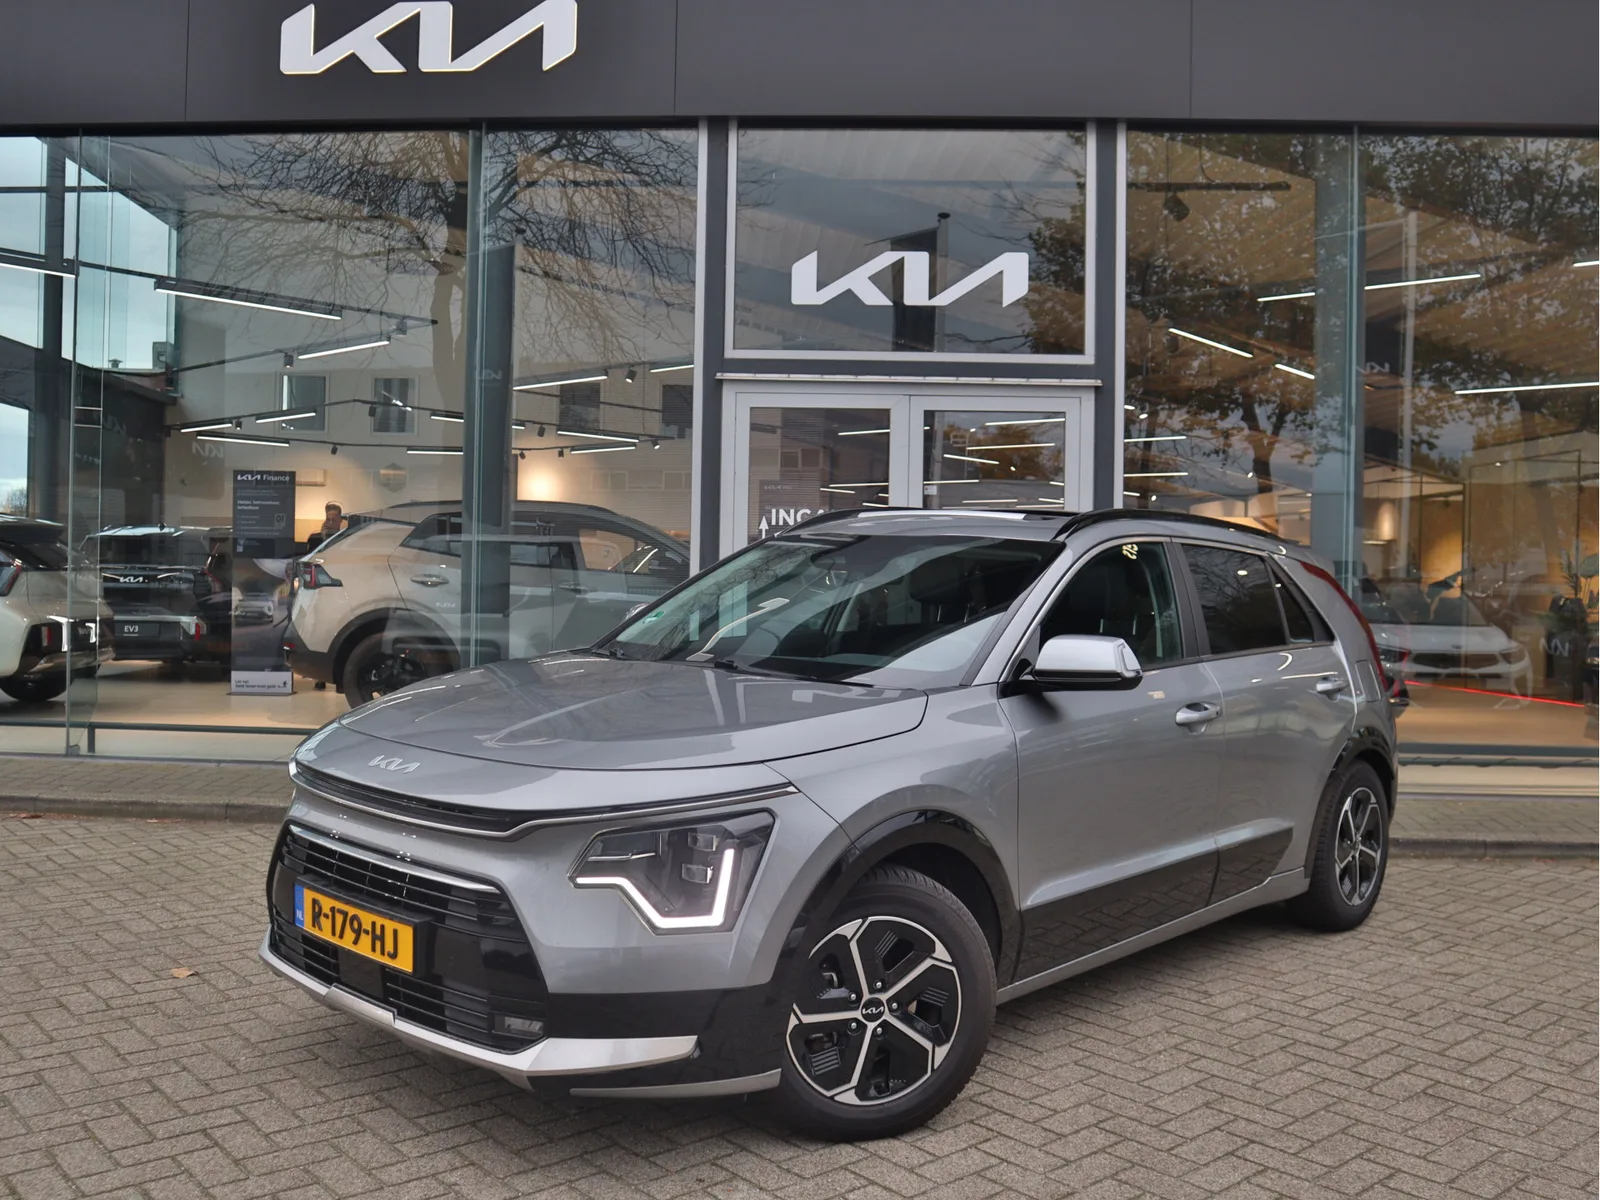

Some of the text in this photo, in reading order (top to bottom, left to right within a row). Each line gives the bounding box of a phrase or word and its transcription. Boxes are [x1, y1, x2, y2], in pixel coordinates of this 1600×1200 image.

[279, 0, 578, 75] KIA
[791, 250, 1030, 308] KIA
[263, 474, 290, 482] Finance
[124, 625, 139, 633] EV3
[368, 755, 420, 774] KIA
[296, 909, 304, 921] NL
[311, 897, 399, 960] R-179-HJ
[862, 1006, 884, 1014] KIA
